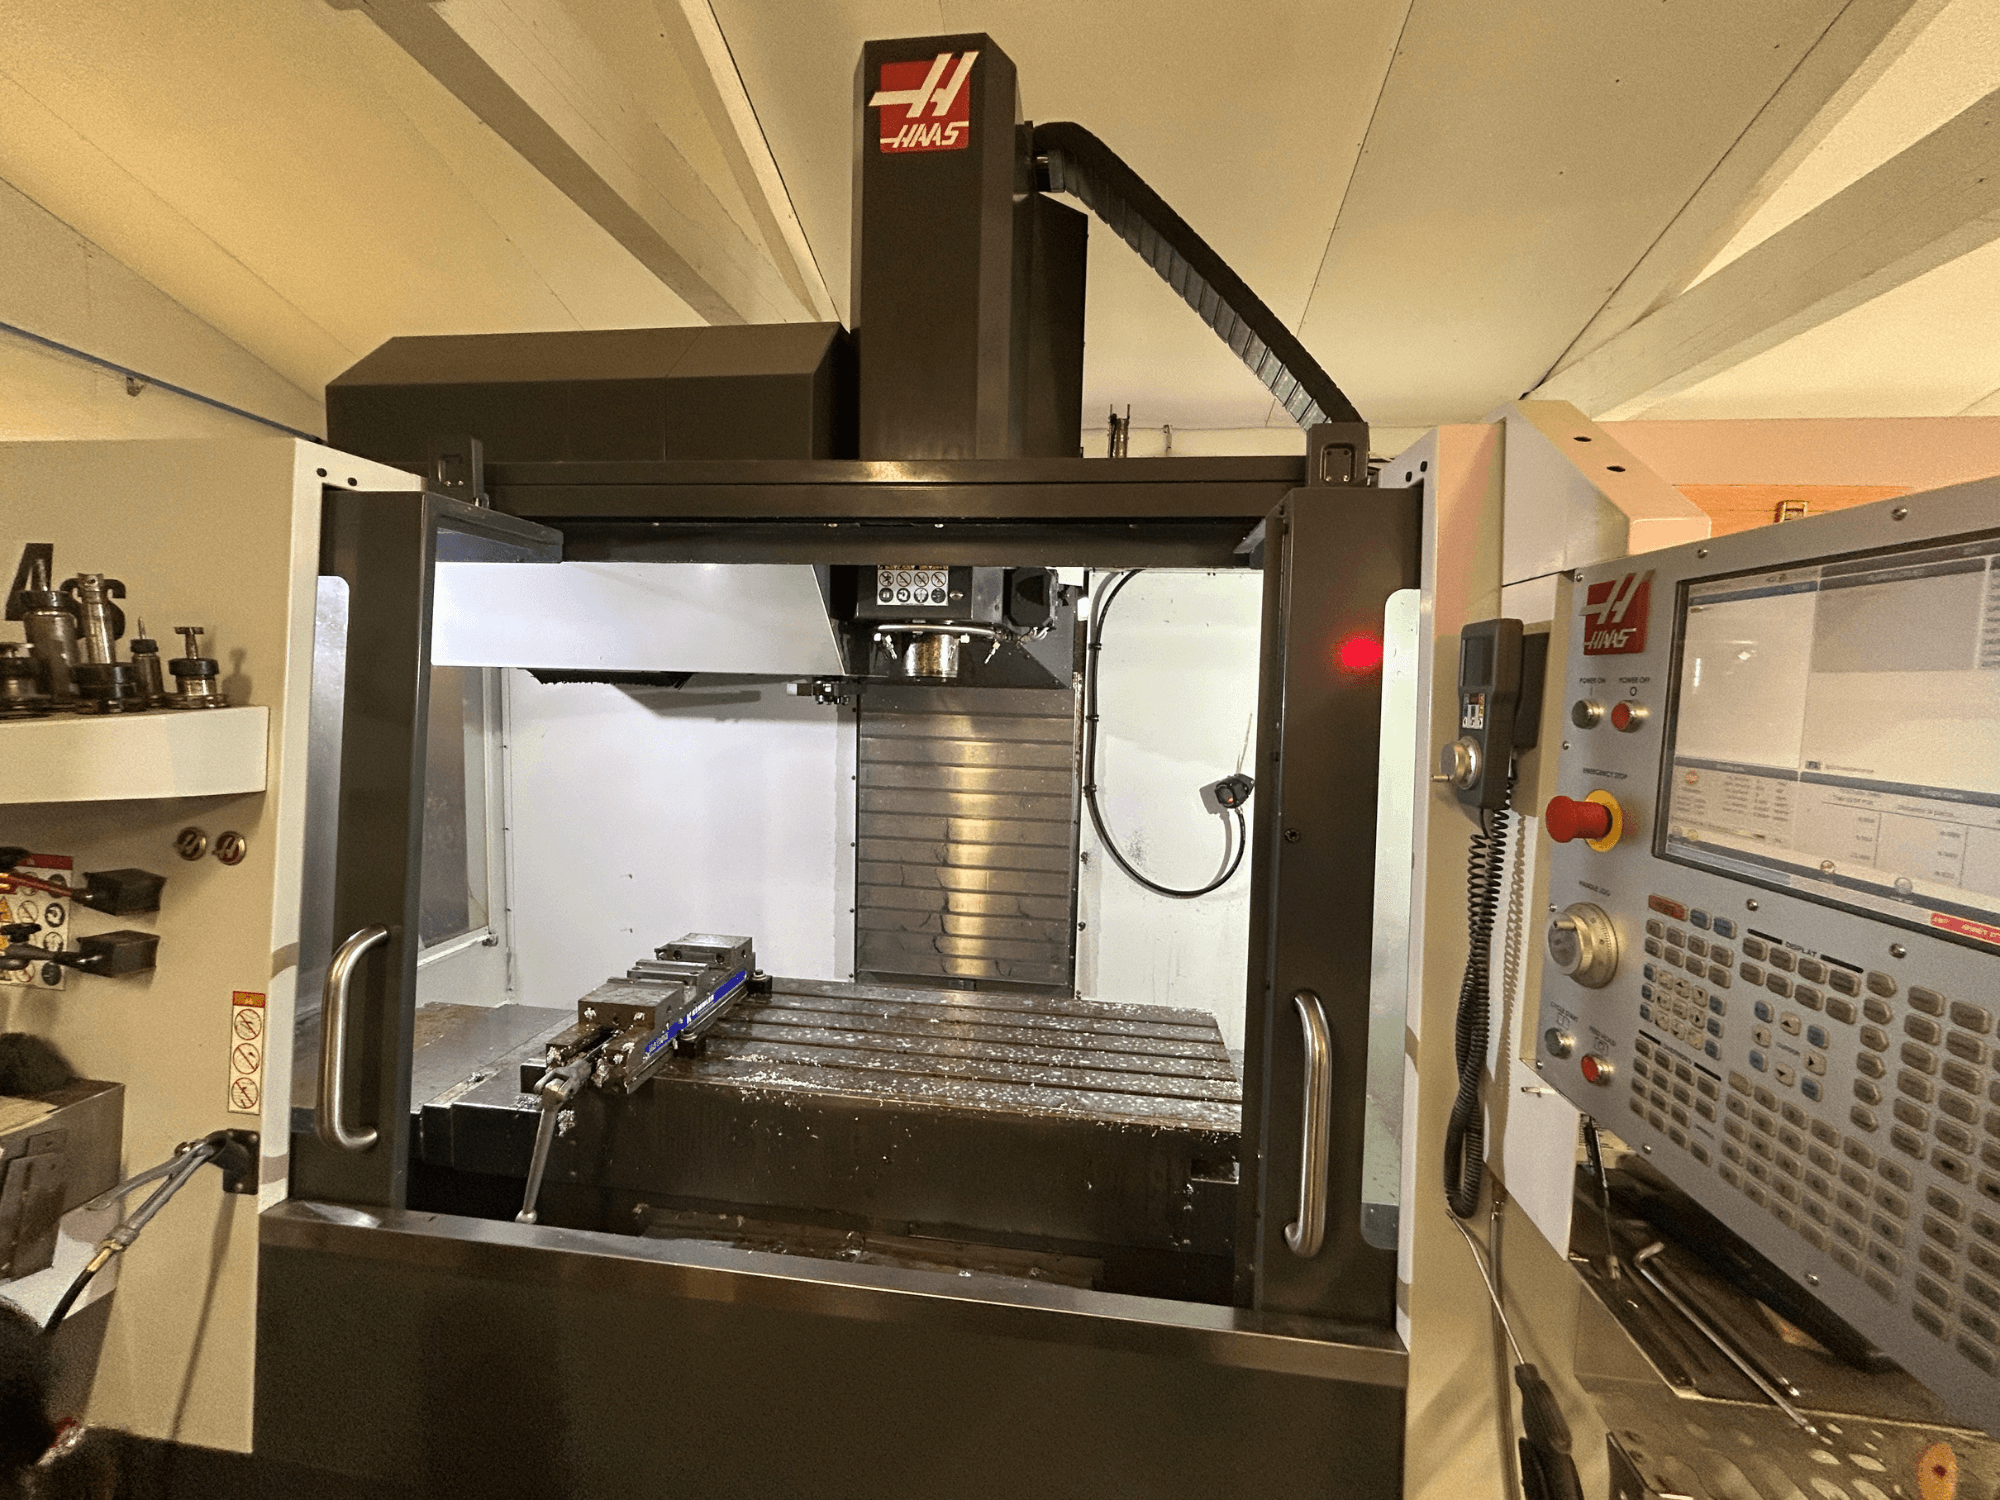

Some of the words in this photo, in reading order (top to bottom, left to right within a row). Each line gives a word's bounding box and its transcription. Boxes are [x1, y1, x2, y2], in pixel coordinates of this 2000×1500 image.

[880, 121, 970, 149] HAAS
[1584, 628, 1637, 650] HAAS
[1785, 941, 1817, 957] DISPLAY
